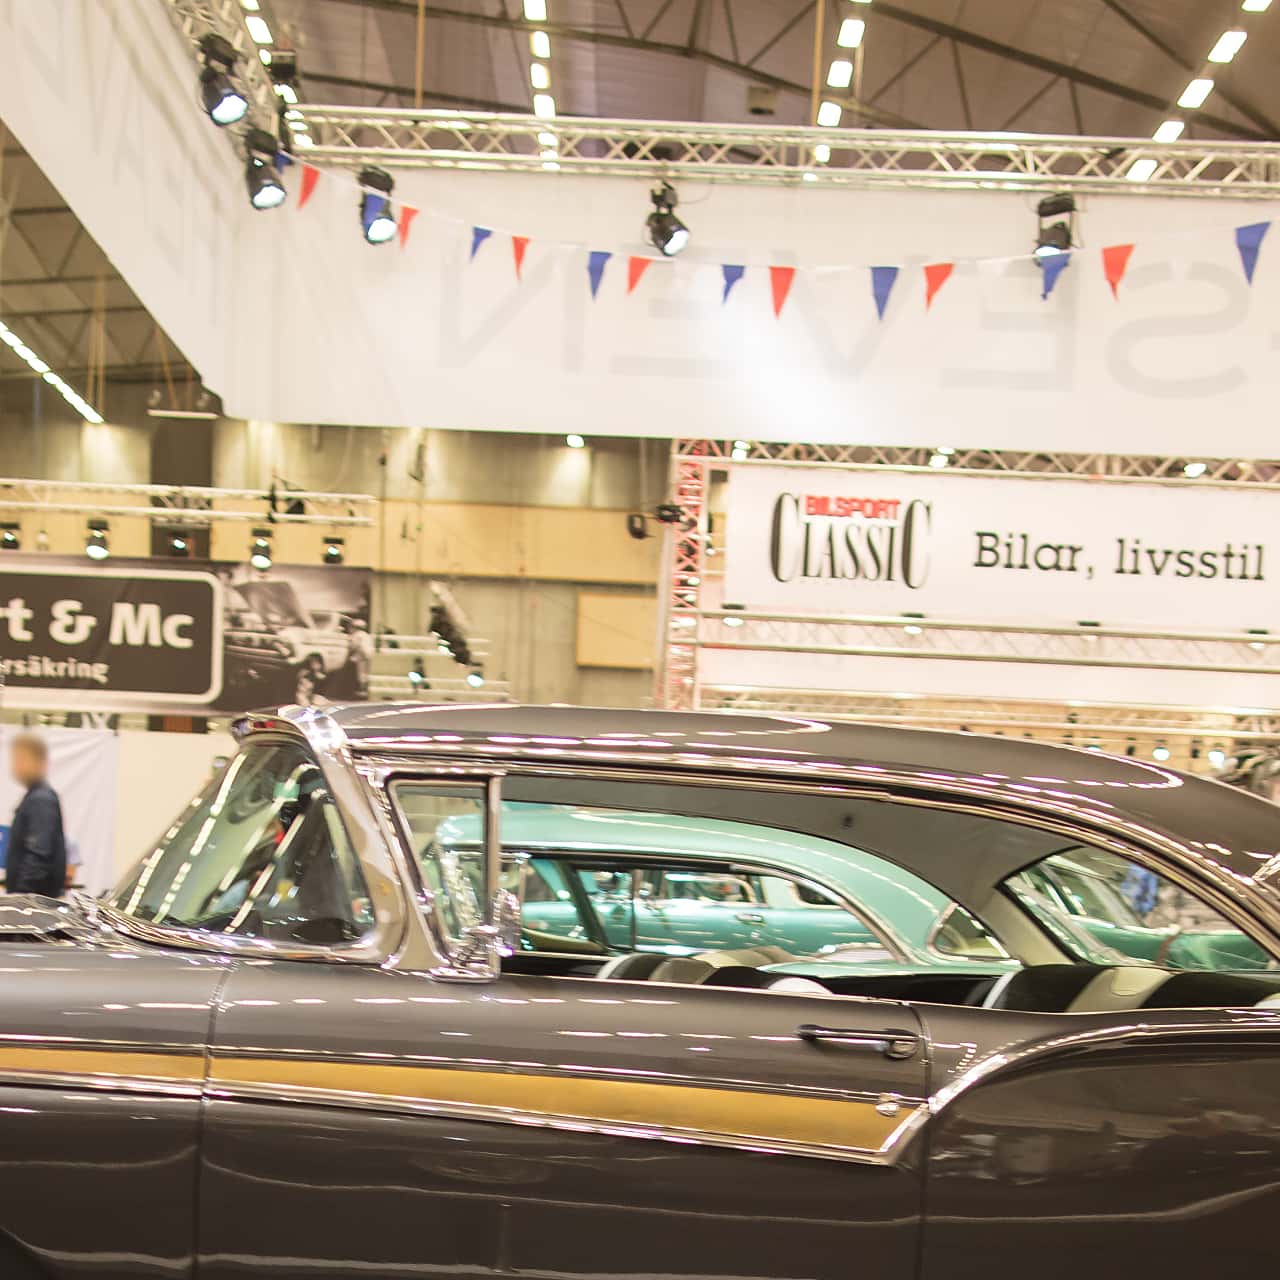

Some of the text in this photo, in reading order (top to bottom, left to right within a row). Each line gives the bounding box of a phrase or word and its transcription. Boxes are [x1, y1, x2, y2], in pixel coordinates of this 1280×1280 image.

[805, 494, 902, 521] BILSPORT
[770, 492, 932, 589] CLASSIC
[973, 531, 1095, 579] Bilar,
[1114, 538, 1265, 581] livsstil
[48, 599, 98, 645] &
[108, 601, 195, 649] Mc
